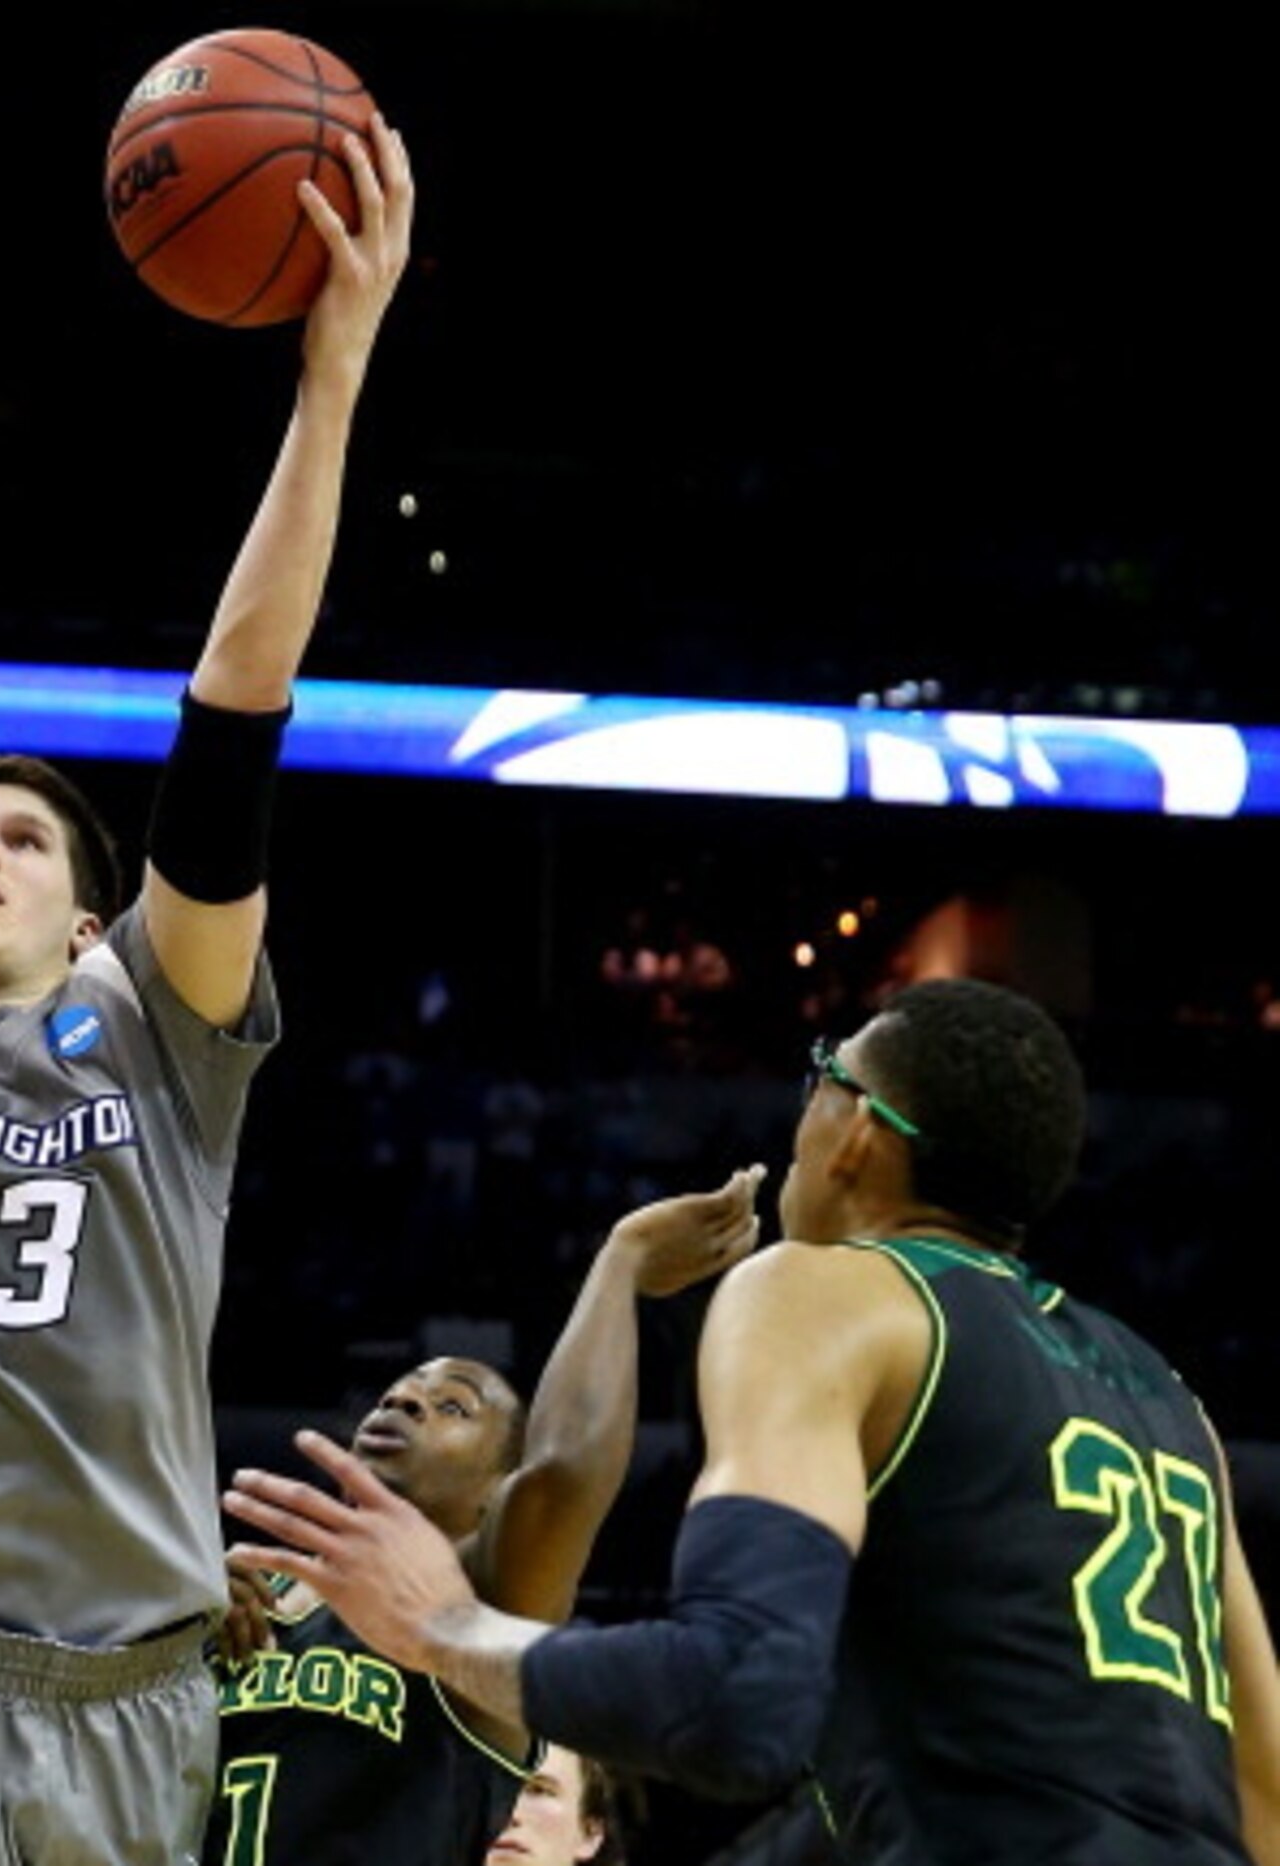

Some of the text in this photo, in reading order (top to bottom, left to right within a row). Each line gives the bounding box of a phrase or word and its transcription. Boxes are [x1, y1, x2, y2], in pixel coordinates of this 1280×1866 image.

[111, 141, 179, 218] CAA
[1049, 1416, 1234, 1733] 21
[218, 1647, 405, 1742] YLOR
[223, 1755, 279, 1866] 1
